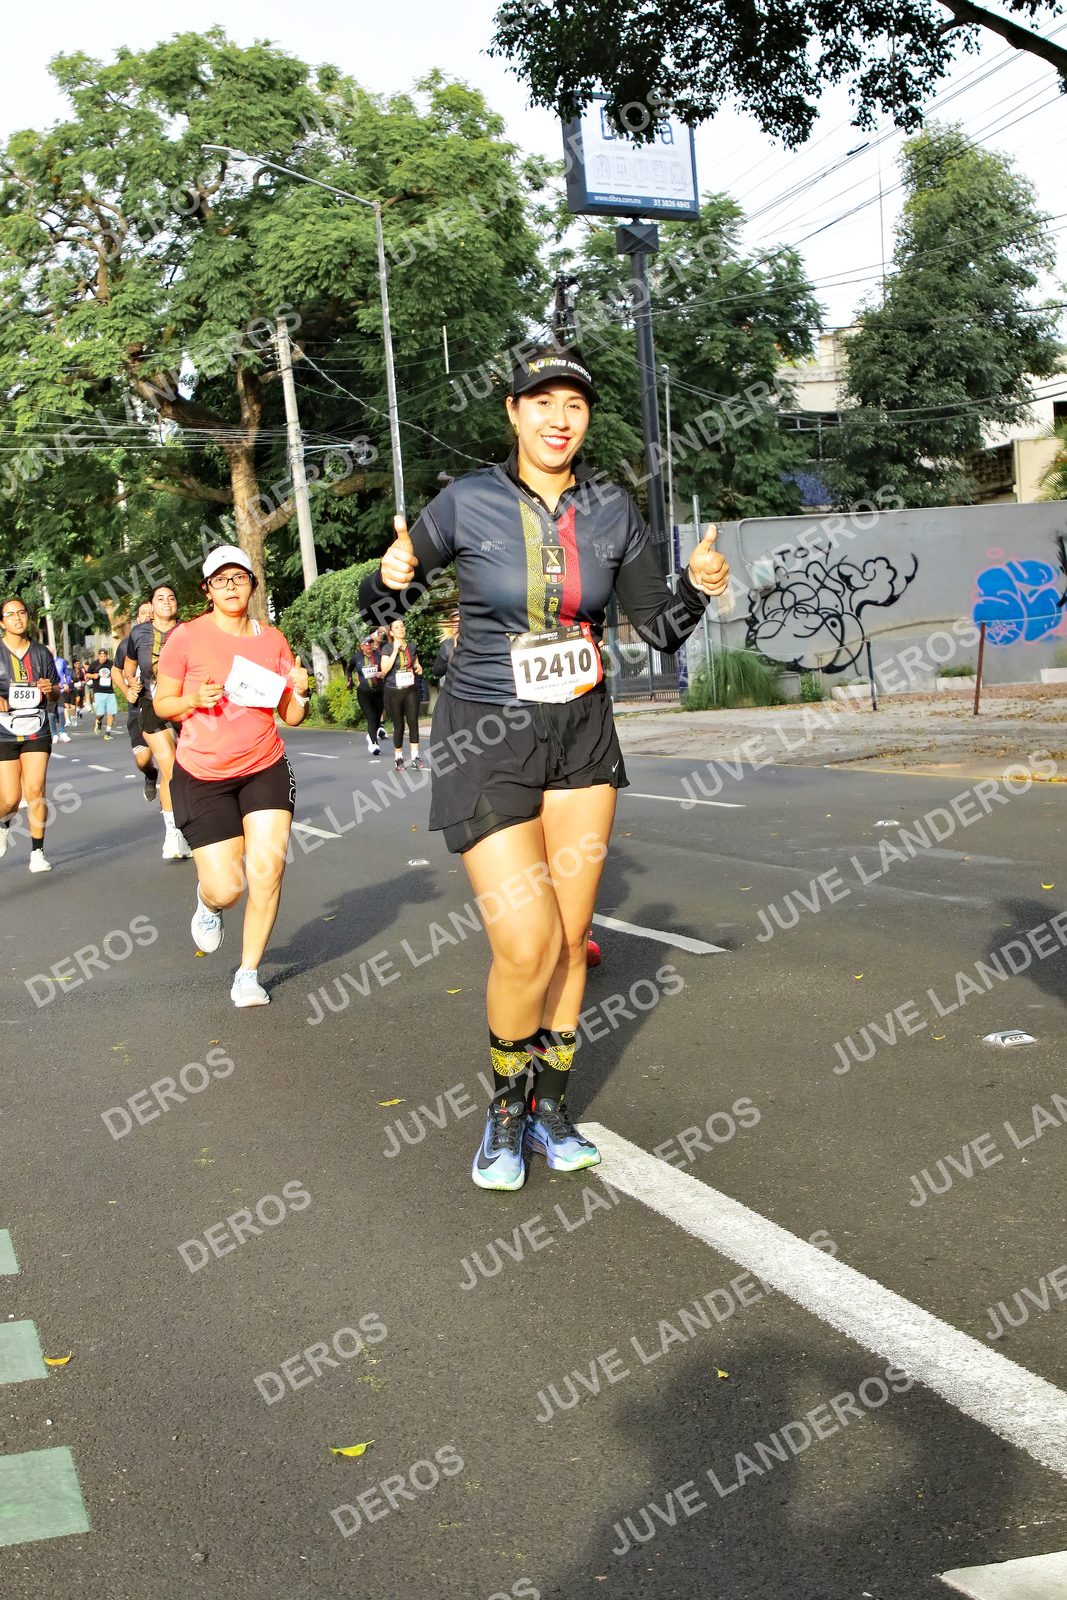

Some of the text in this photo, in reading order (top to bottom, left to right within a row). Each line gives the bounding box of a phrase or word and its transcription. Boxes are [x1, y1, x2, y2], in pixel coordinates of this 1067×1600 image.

[775, 542, 833, 565] TOY
[519, 648, 592, 684] 12410
[14, 690, 35, 699] 8581
